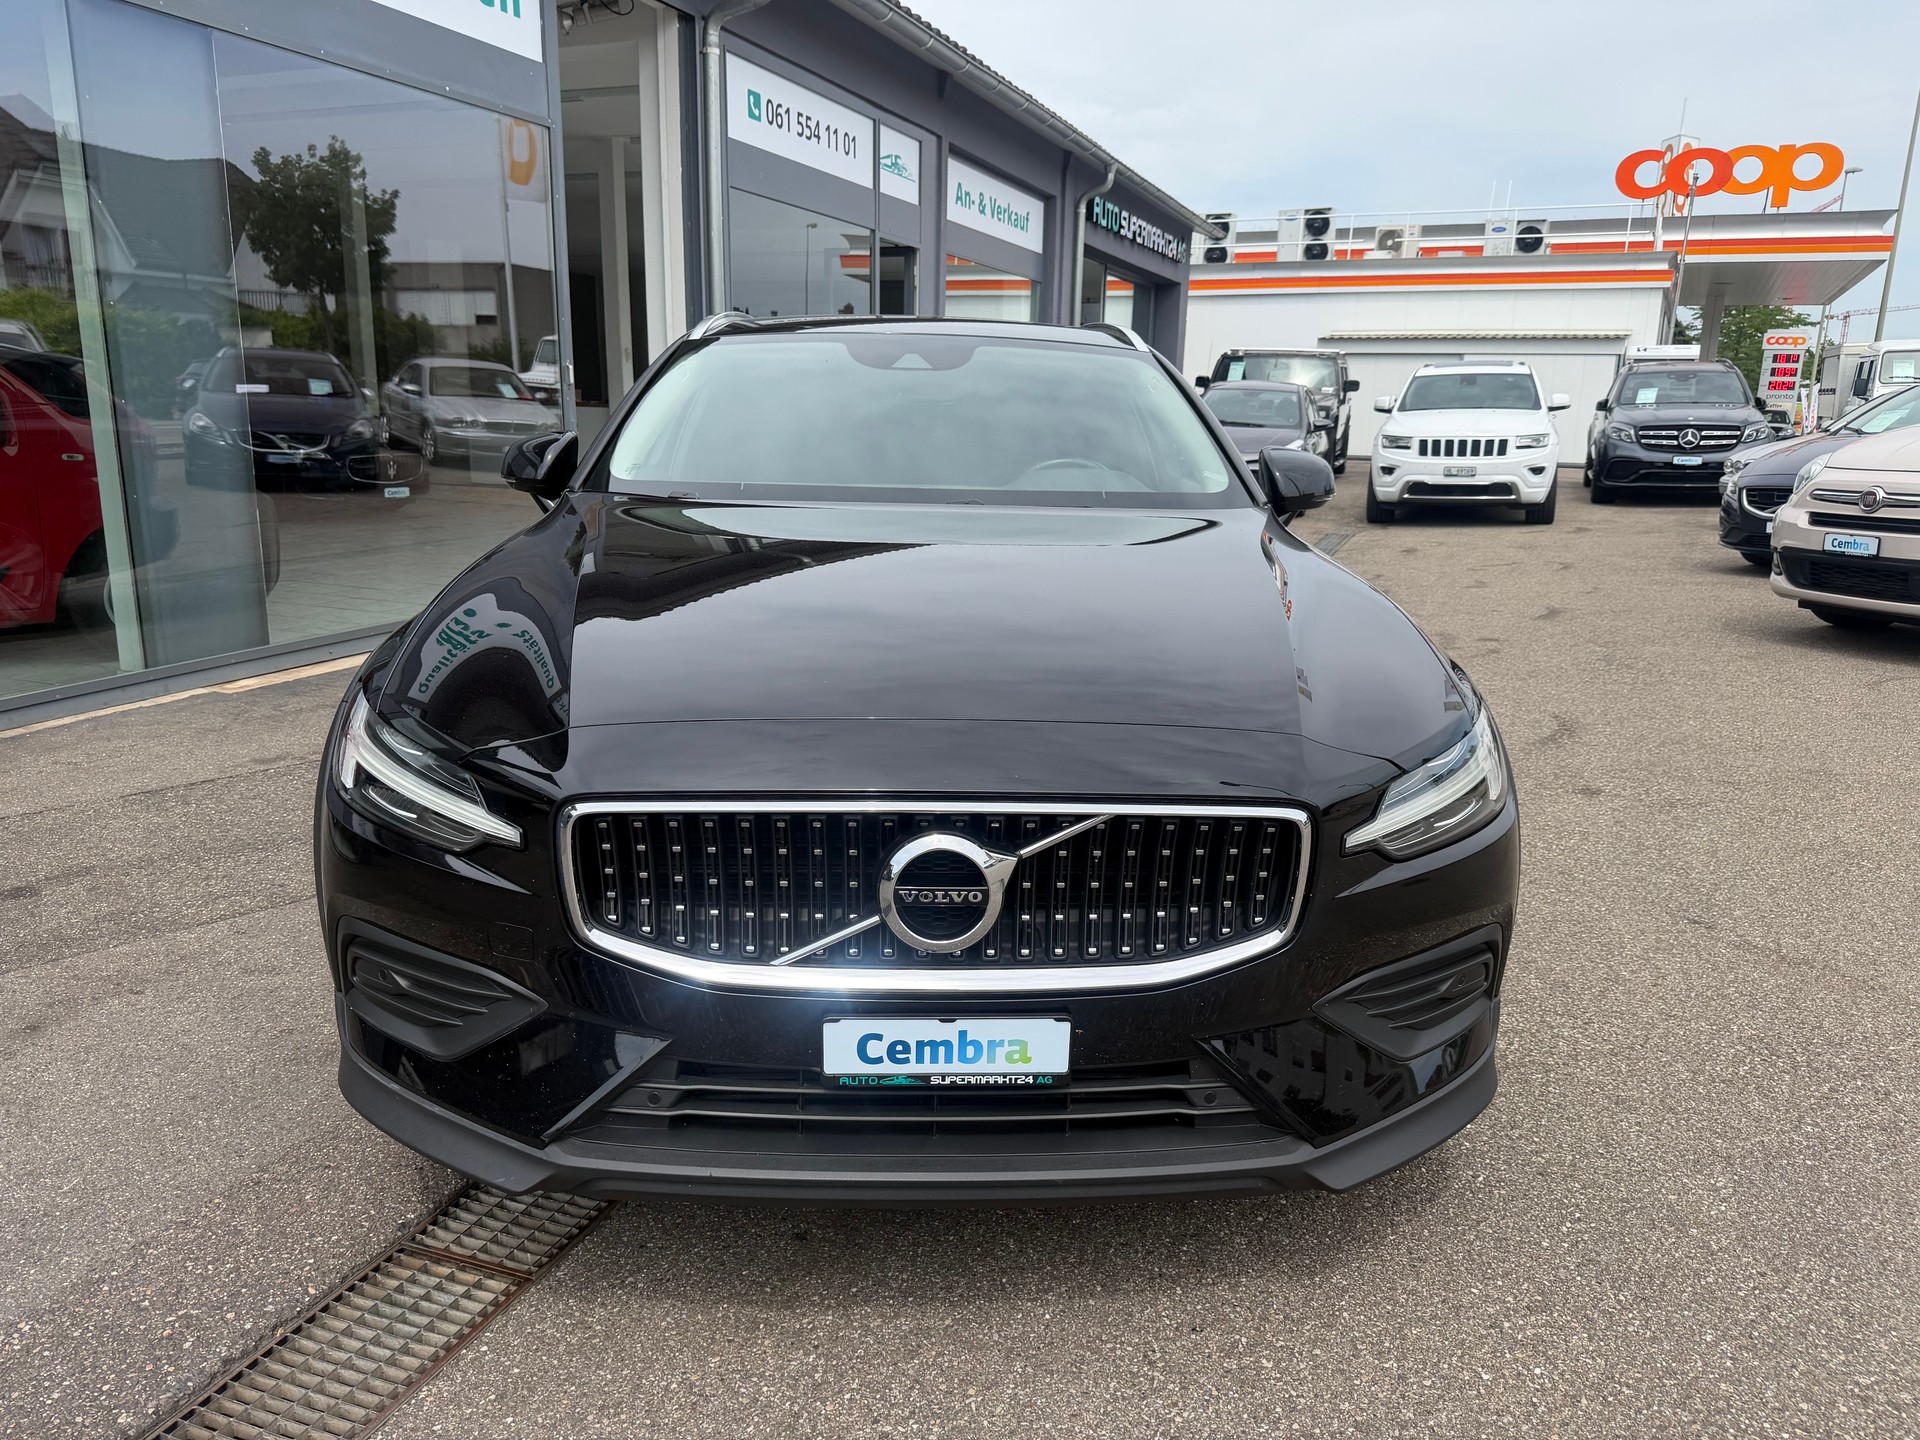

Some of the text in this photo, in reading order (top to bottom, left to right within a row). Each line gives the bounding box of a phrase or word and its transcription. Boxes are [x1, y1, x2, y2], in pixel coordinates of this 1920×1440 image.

[766, 99, 857, 159] 061 554 11 01
[1615, 142, 1845, 208] coop
[955, 182, 1030, 233] An- & Verkauf
[1093, 196, 1120, 233] AUTO
[1766, 336, 1807, 348] coop
[1863, 495, 1876, 505] FIAT
[1831, 537, 1870, 552] Cembra
[898, 890, 984, 903] VOLVO
[855, 1029, 1033, 1066] Cembra
[839, 1075, 1053, 1085] AUTO SUPERMARKT24 AG
